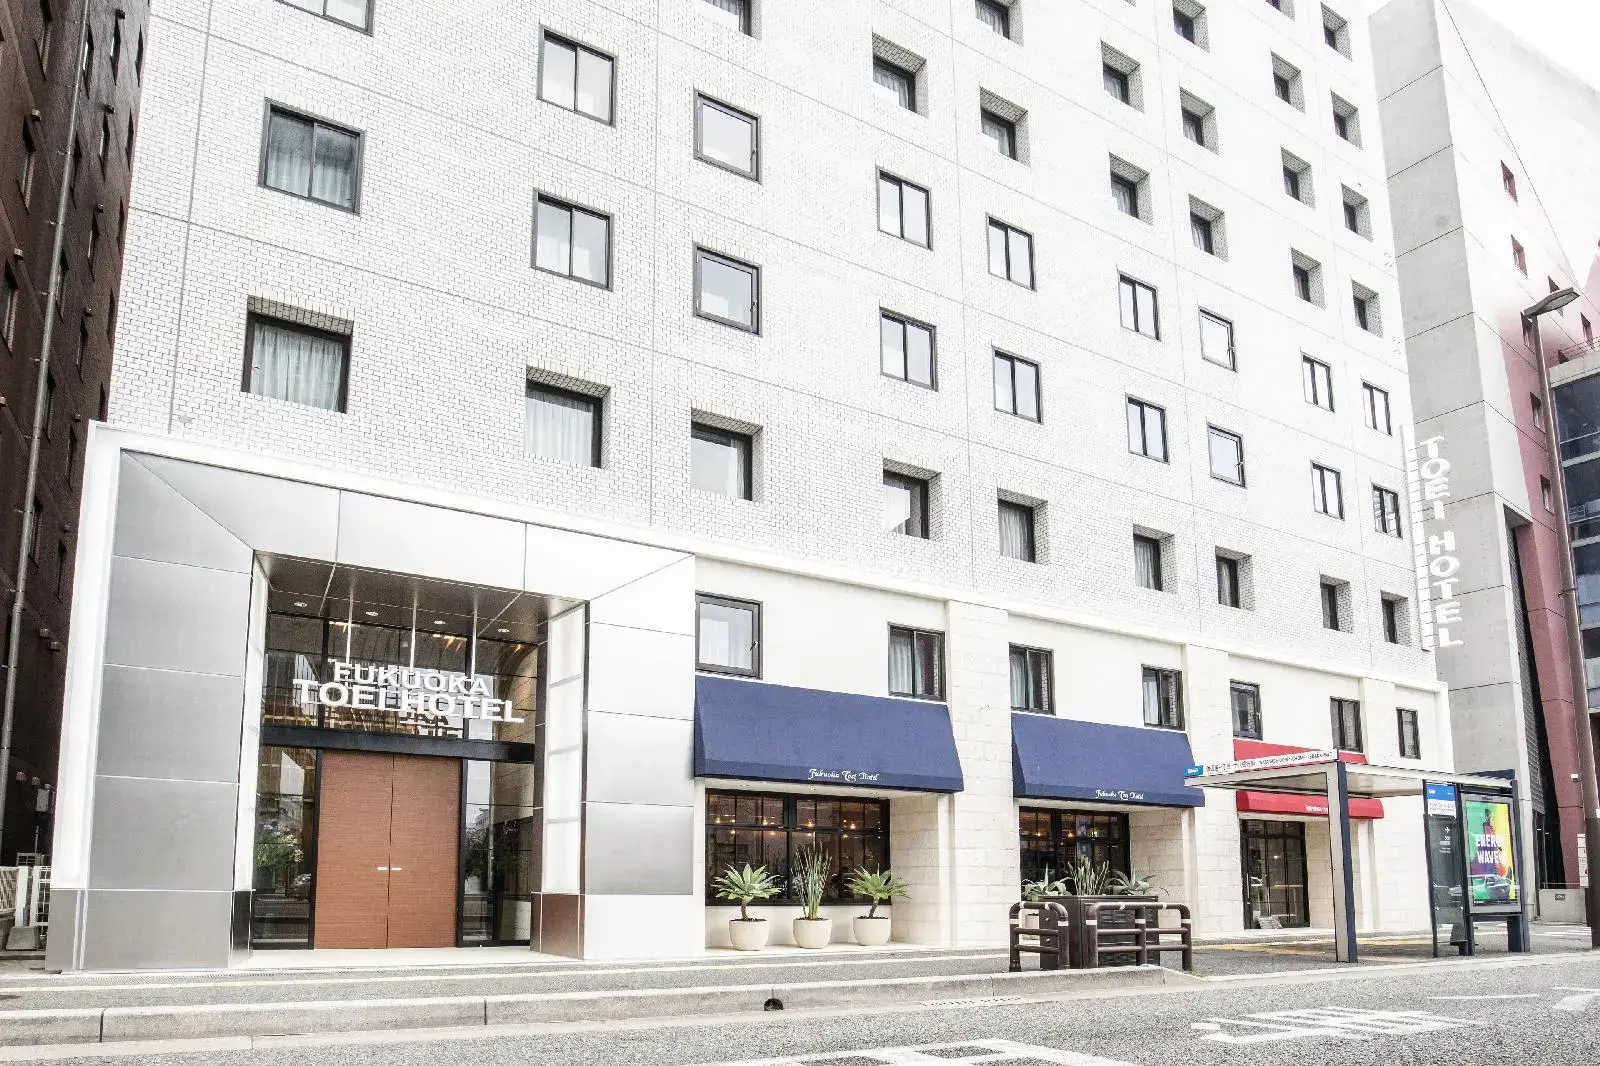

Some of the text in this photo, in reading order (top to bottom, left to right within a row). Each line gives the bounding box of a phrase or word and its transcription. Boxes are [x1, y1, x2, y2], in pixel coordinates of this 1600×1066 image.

[1420, 435, 1465, 648] TOEI HOTEL
[333, 660, 490, 697] FUKUOKA
[292, 679, 525, 723] TOEI HOTEL
[808, 768, 840, 780] Fukuoka
